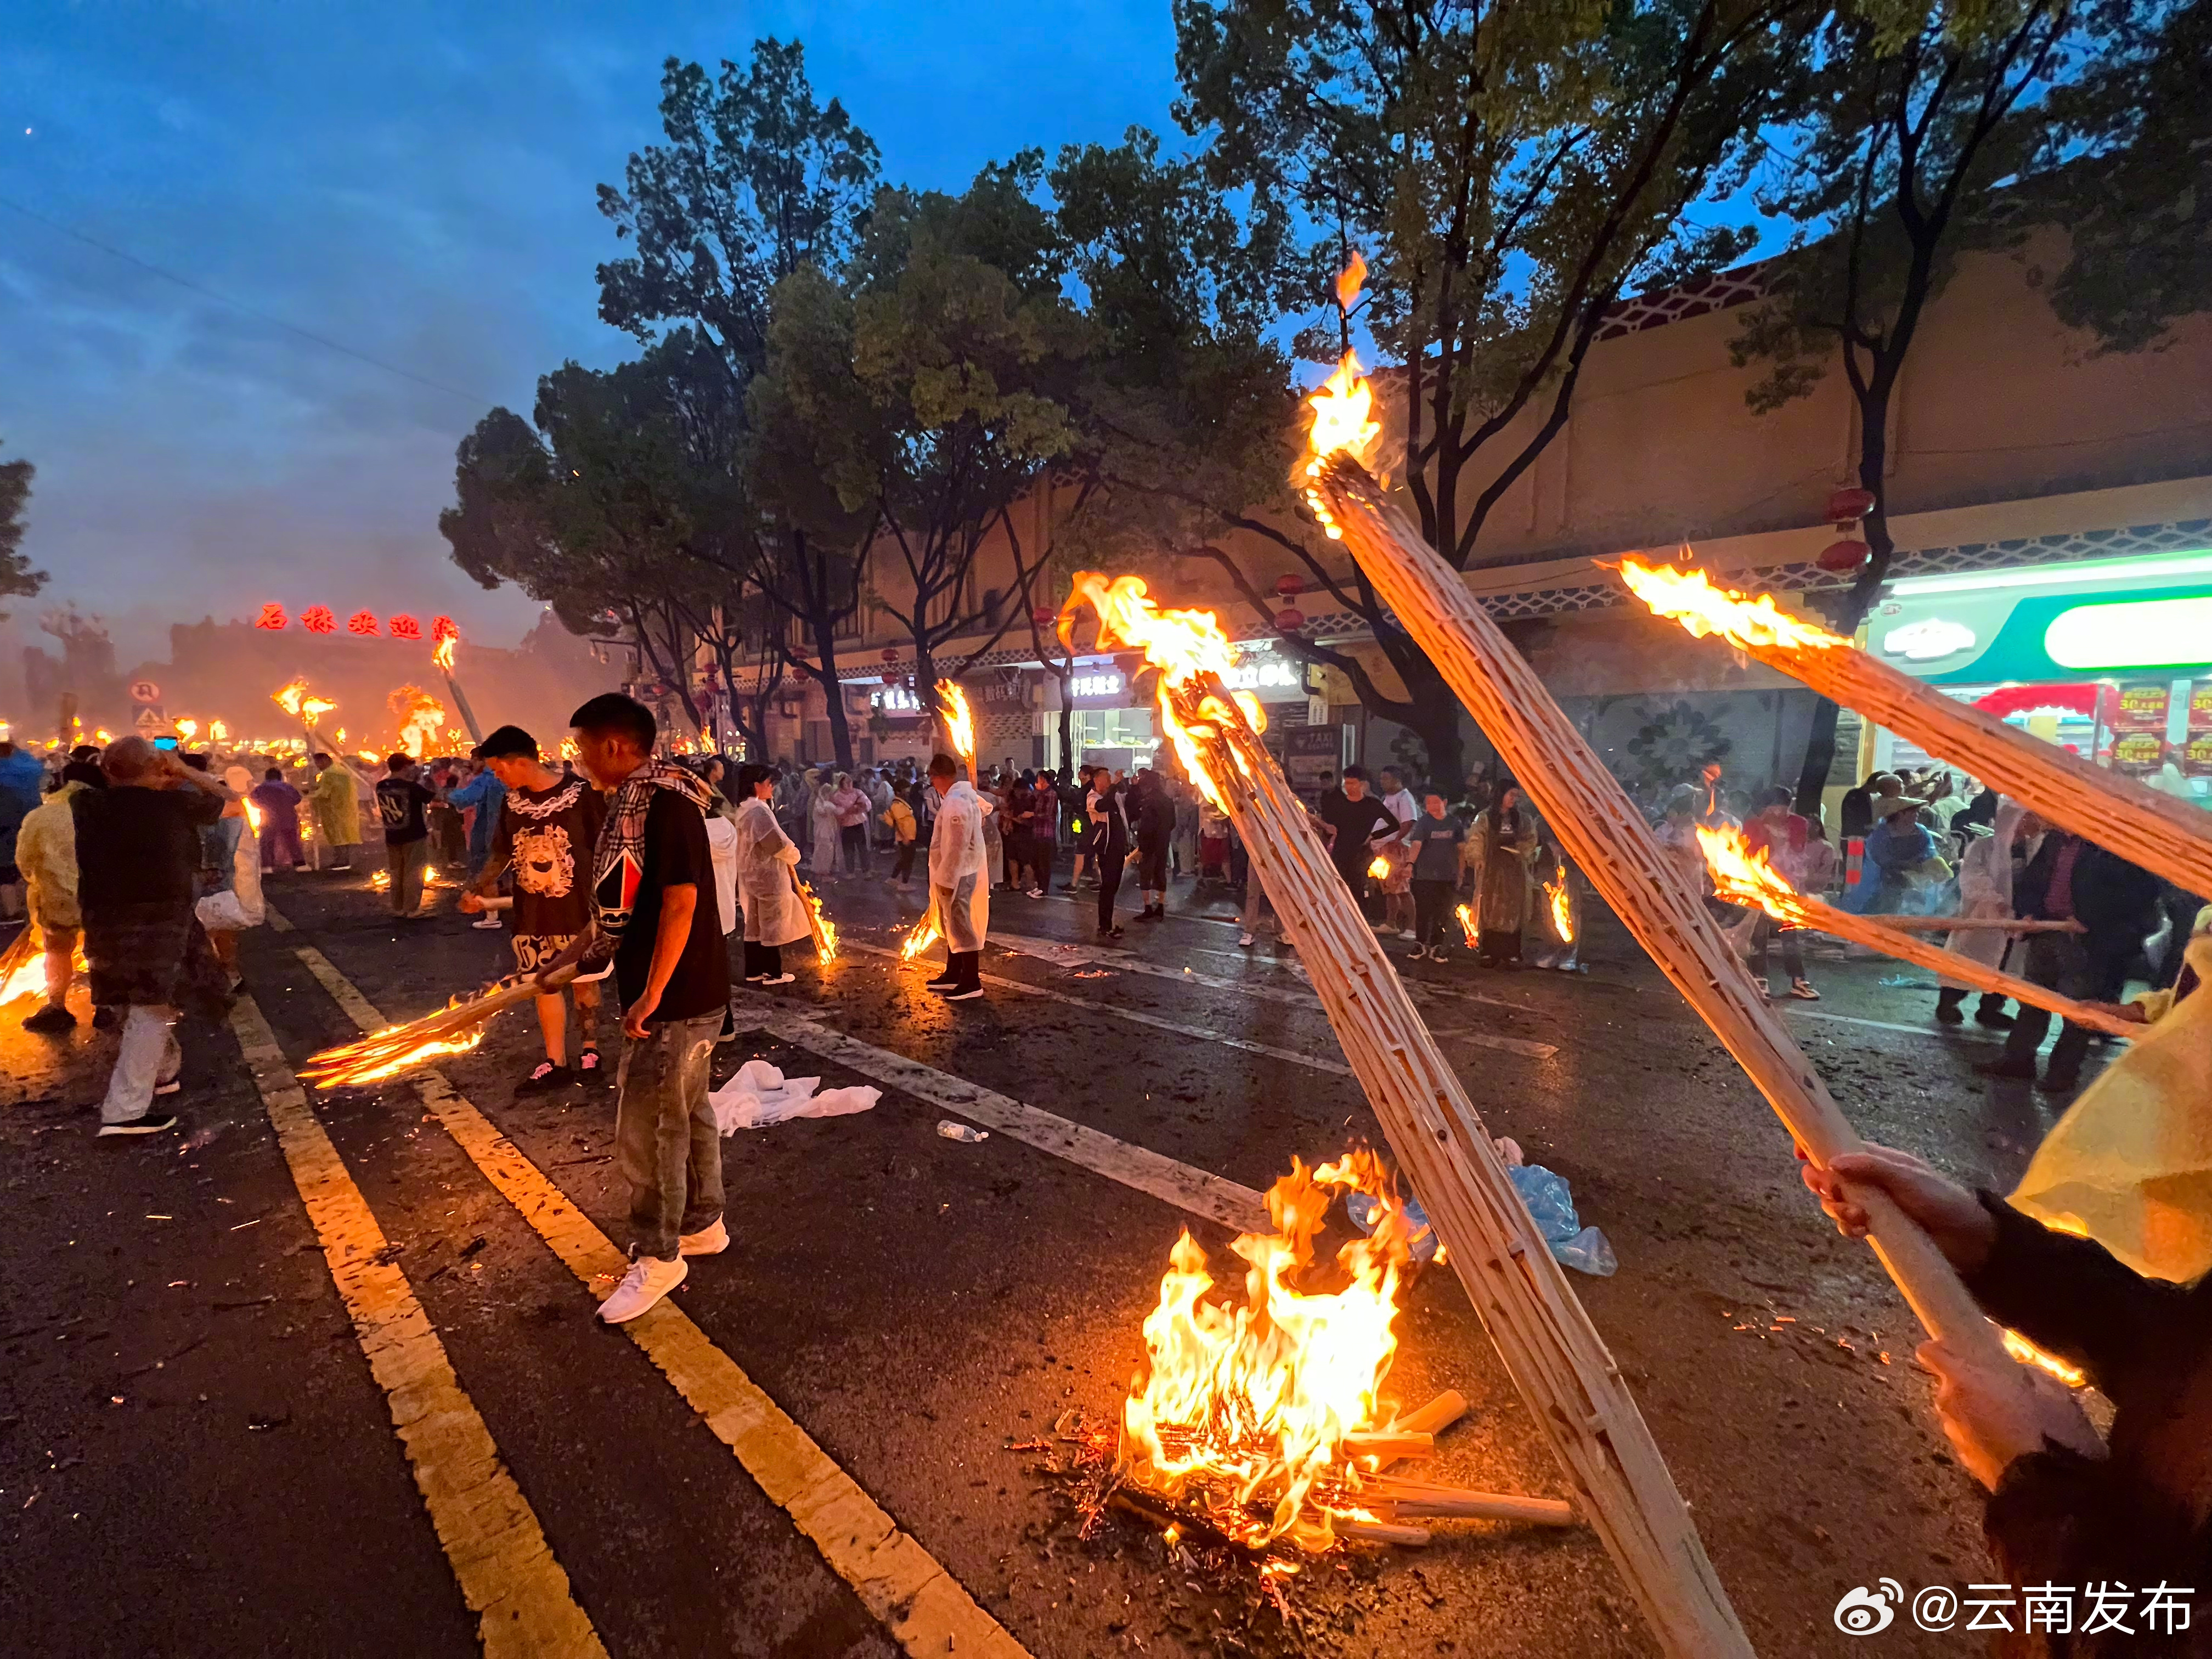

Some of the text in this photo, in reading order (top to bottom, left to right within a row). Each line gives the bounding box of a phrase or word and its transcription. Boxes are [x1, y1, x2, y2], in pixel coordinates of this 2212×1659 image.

[255, 603, 460, 641] 石林欢迎您
